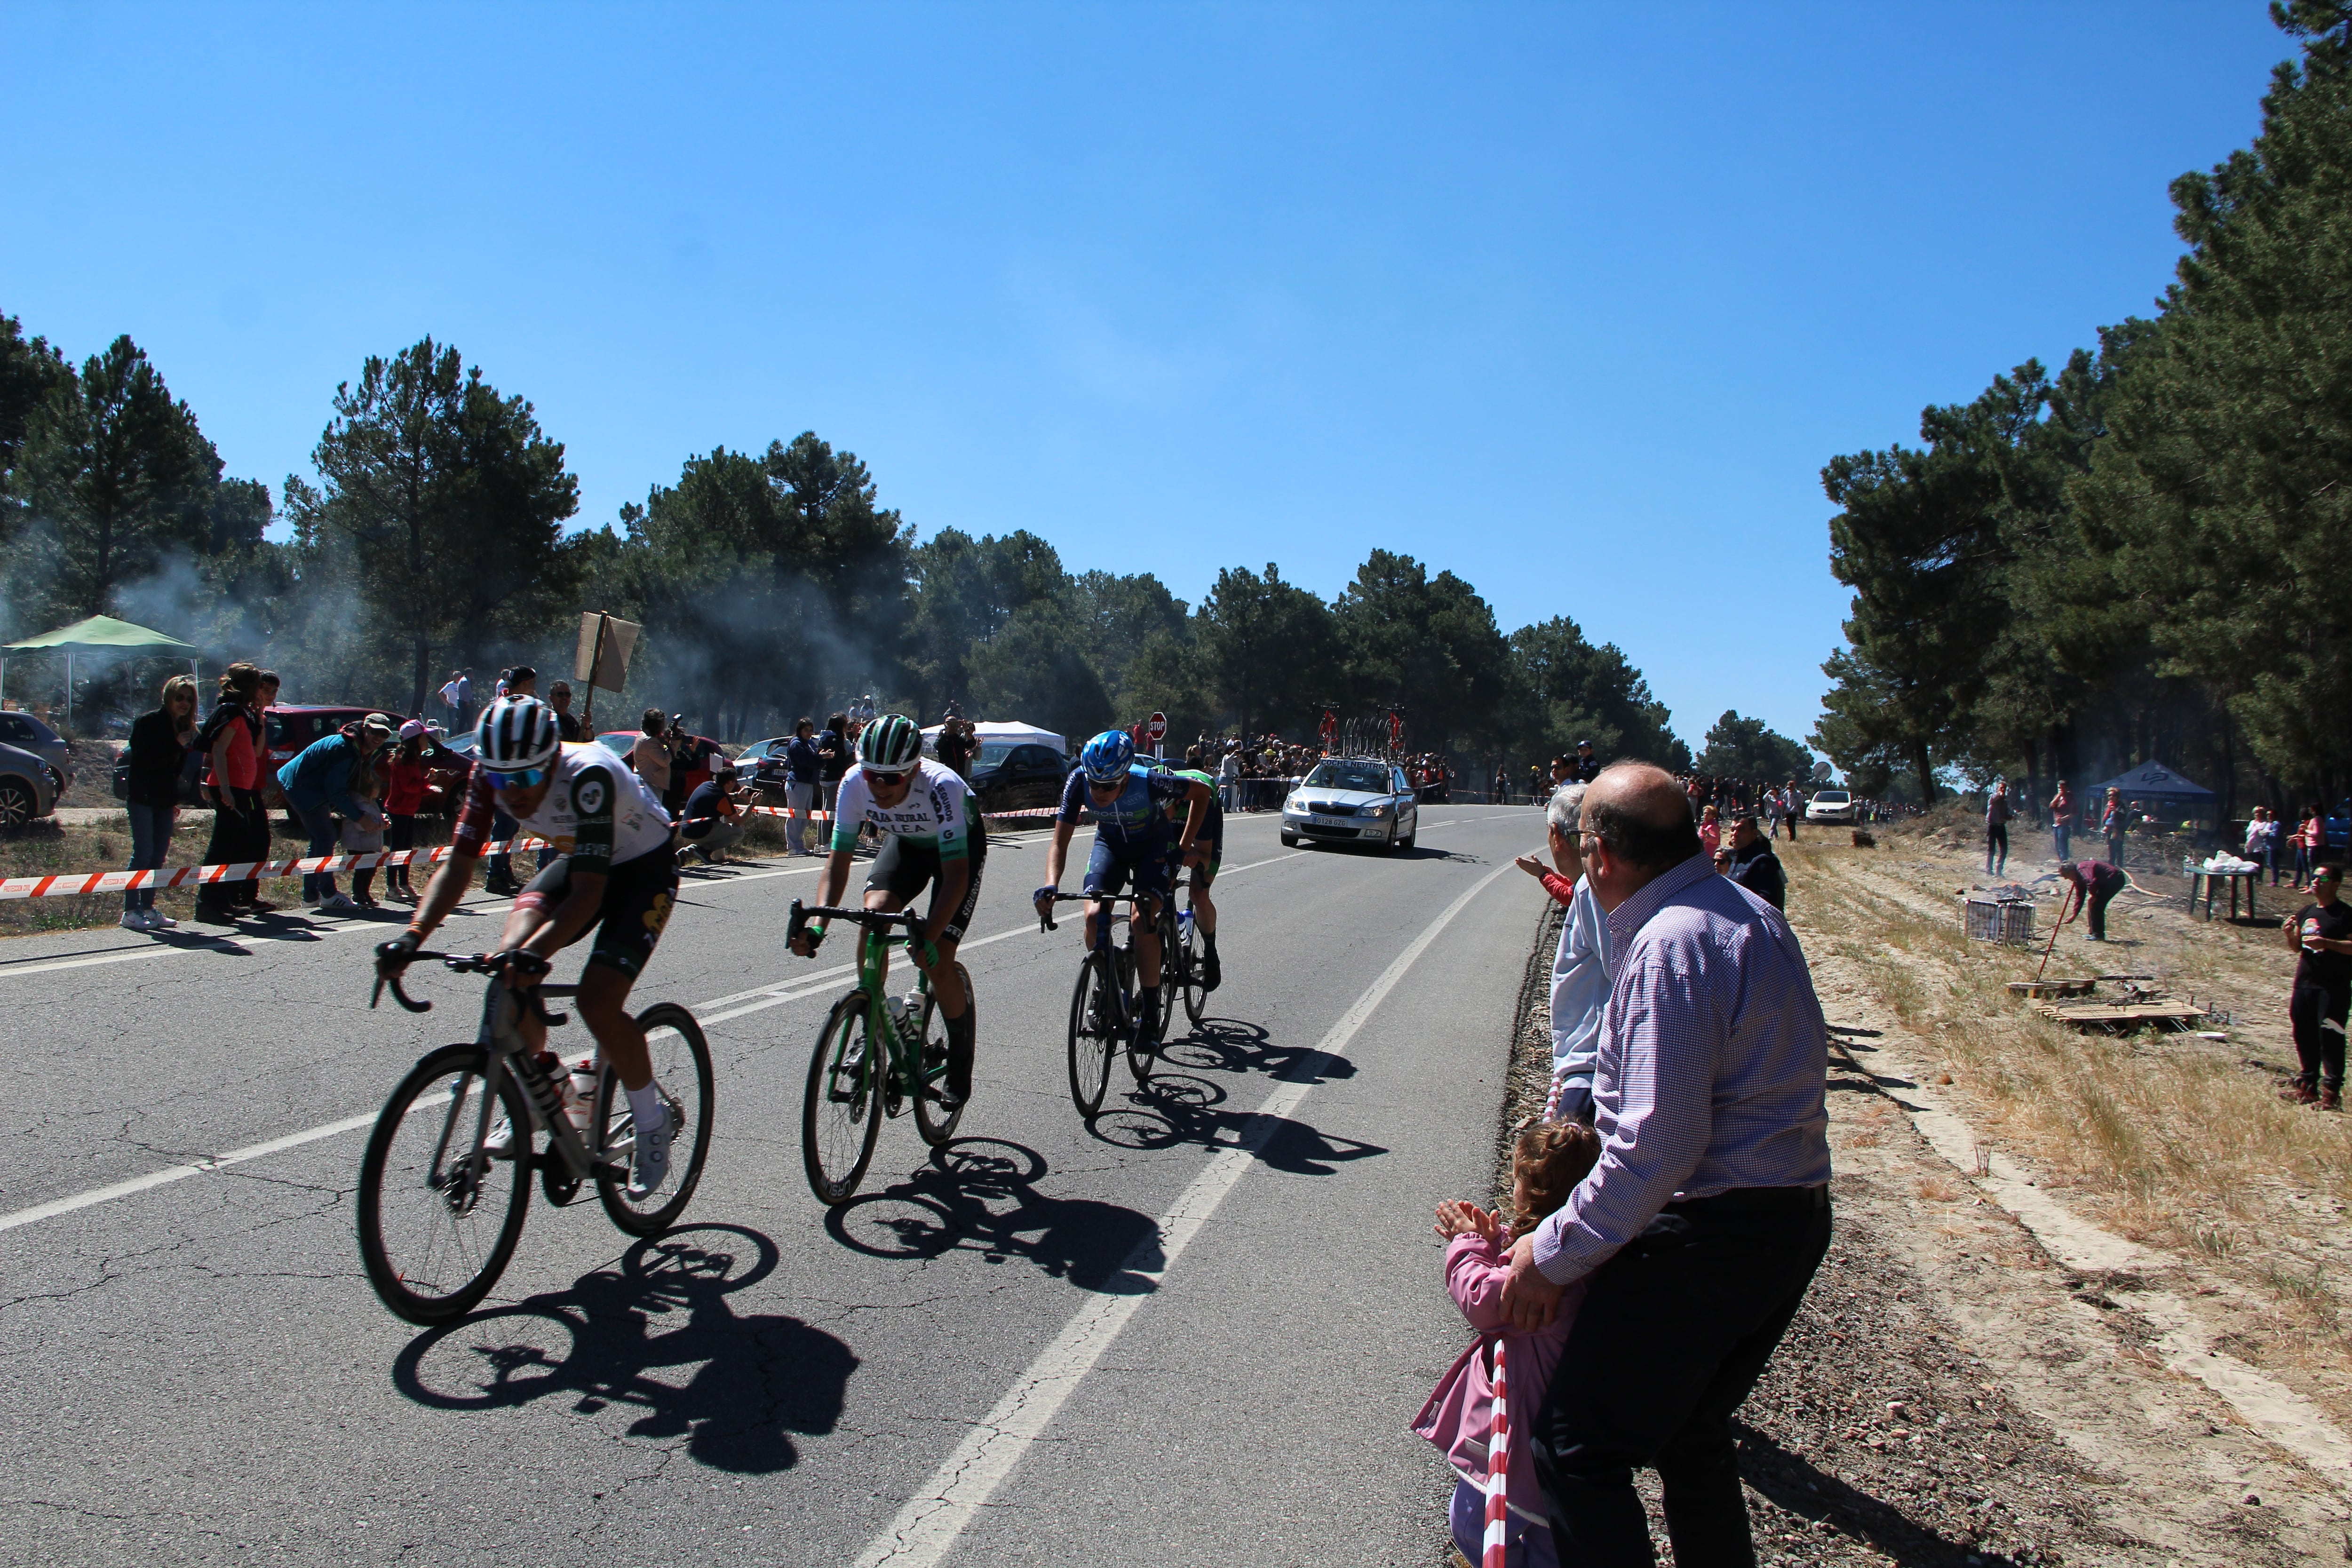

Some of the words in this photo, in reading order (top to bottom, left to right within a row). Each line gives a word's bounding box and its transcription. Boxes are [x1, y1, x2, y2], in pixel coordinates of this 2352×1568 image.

[1150, 721, 1165, 731] STOP
[1351, 761, 1384, 770] NEUTRO
[935, 782, 953, 822] SEGUROS
[866, 809, 892, 822] CAJA
[894, 812, 930, 822] RURAL
[962, 878, 981, 918] SEGUROS
